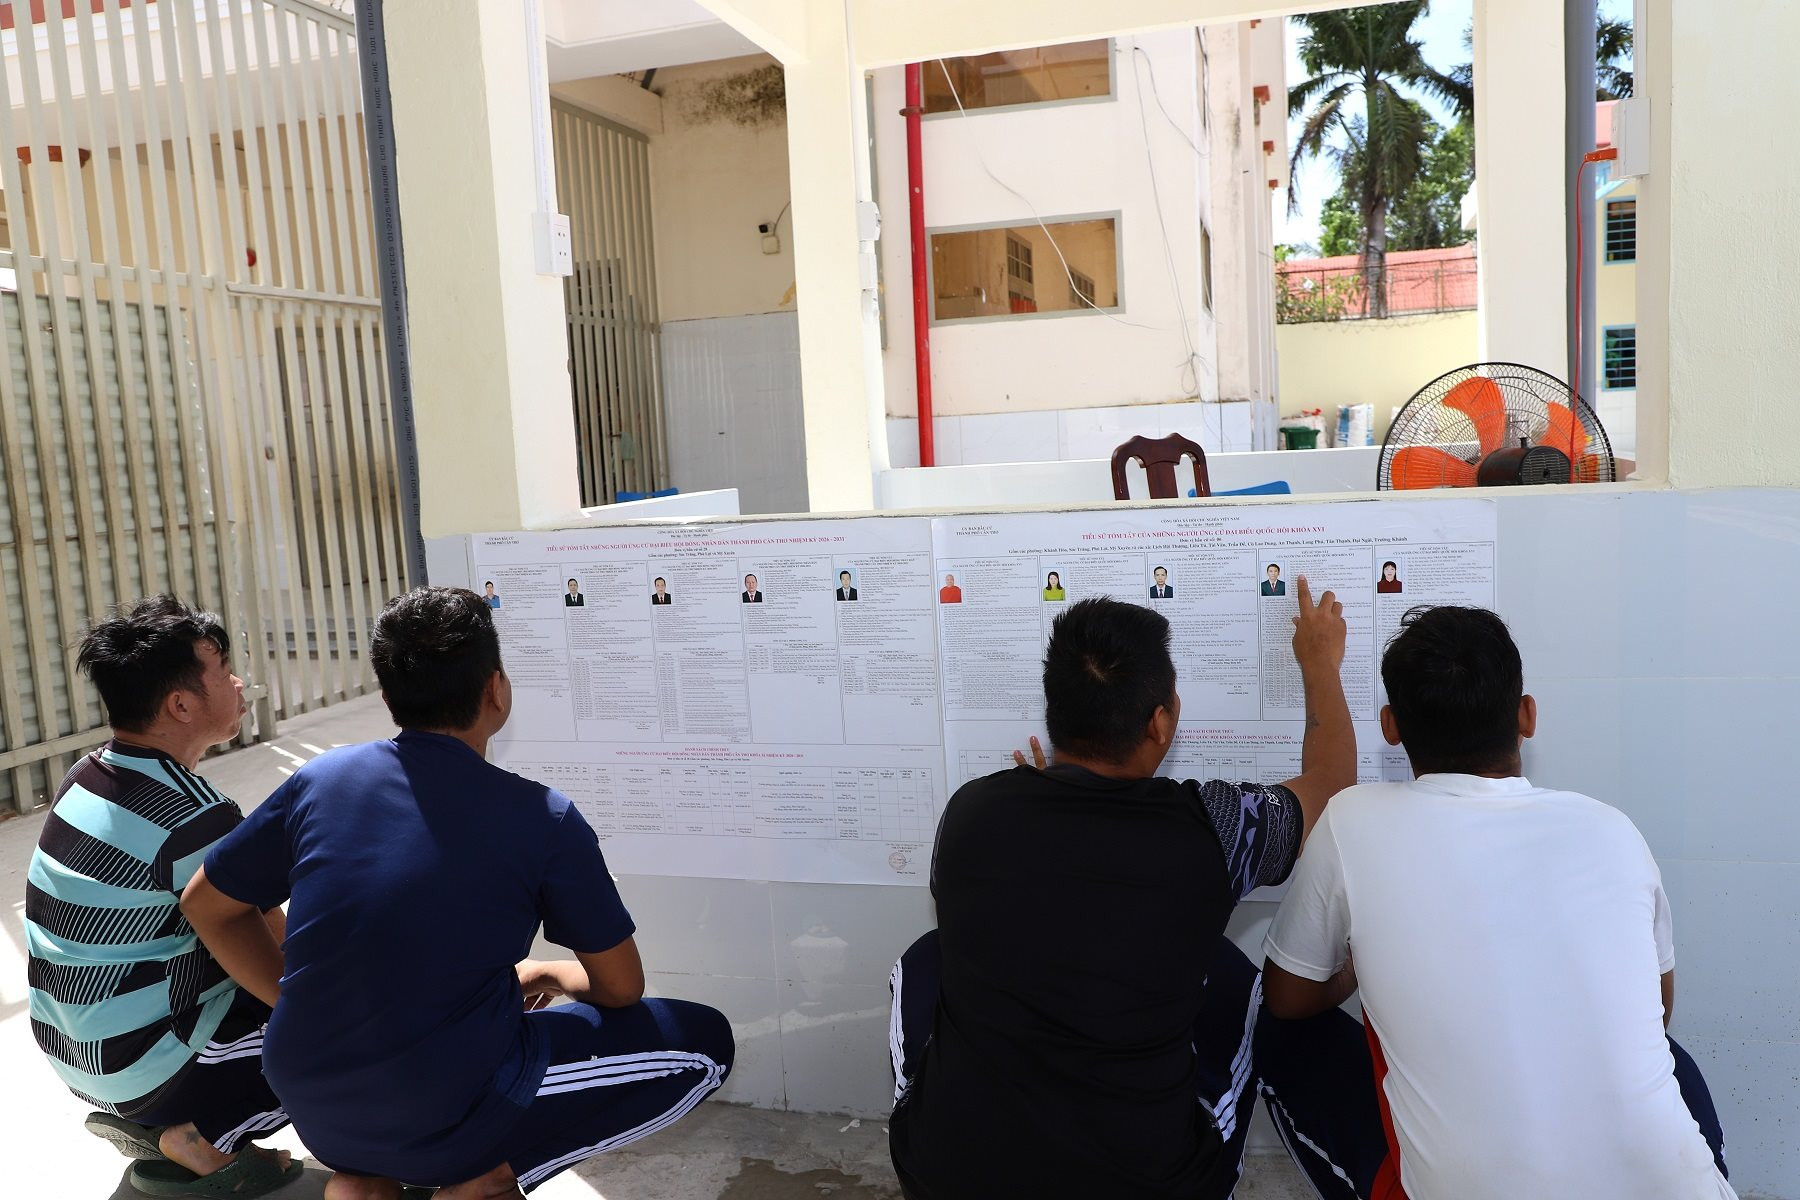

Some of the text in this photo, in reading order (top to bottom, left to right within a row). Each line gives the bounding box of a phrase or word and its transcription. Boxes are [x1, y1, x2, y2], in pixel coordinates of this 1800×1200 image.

[401, 397, 410, 422] PVC-U
[1082, 532, 1096, 540] TIỂU
[1098, 531, 1106, 539] SỬ
[1107, 531, 1122, 539] TÓM
[1123, 530, 1137, 538] TẮT
[1137, 530, 1151, 538] CỦA
[1152, 529, 1176, 537] NHỮNG
[1176, 528, 1198, 537] NGƯỜI
[1199, 528, 1214, 536] ỨNG
[1214, 528, 1225, 536] CỬ
[1225, 527, 1238, 536] ĐẠI
[1238, 527, 1254, 535] BIỂU
[1255, 526, 1275, 535] QUỐC
[1277, 525, 1290, 534] HỘI
[1290, 525, 1311, 533] KHÓA
[566, 543, 579, 551] TÓM
[590, 542, 610, 550] NHỮNG
[610, 542, 628, 550] NGƯỜI
[628, 541, 640, 549] ỨNG
[640, 541, 649, 549] CỬ
[650, 541, 660, 549] ĐẠI
[660, 540, 672, 548] BIỂU
[673, 540, 684, 548] HỘI
[684, 539, 701, 547] ĐỒNG
[701, 539, 717, 547] NHÂN
[730, 538, 750, 546] THÀNH
[762, 537, 775, 545] CẦN
[788, 536, 808, 545] NHIỆM
